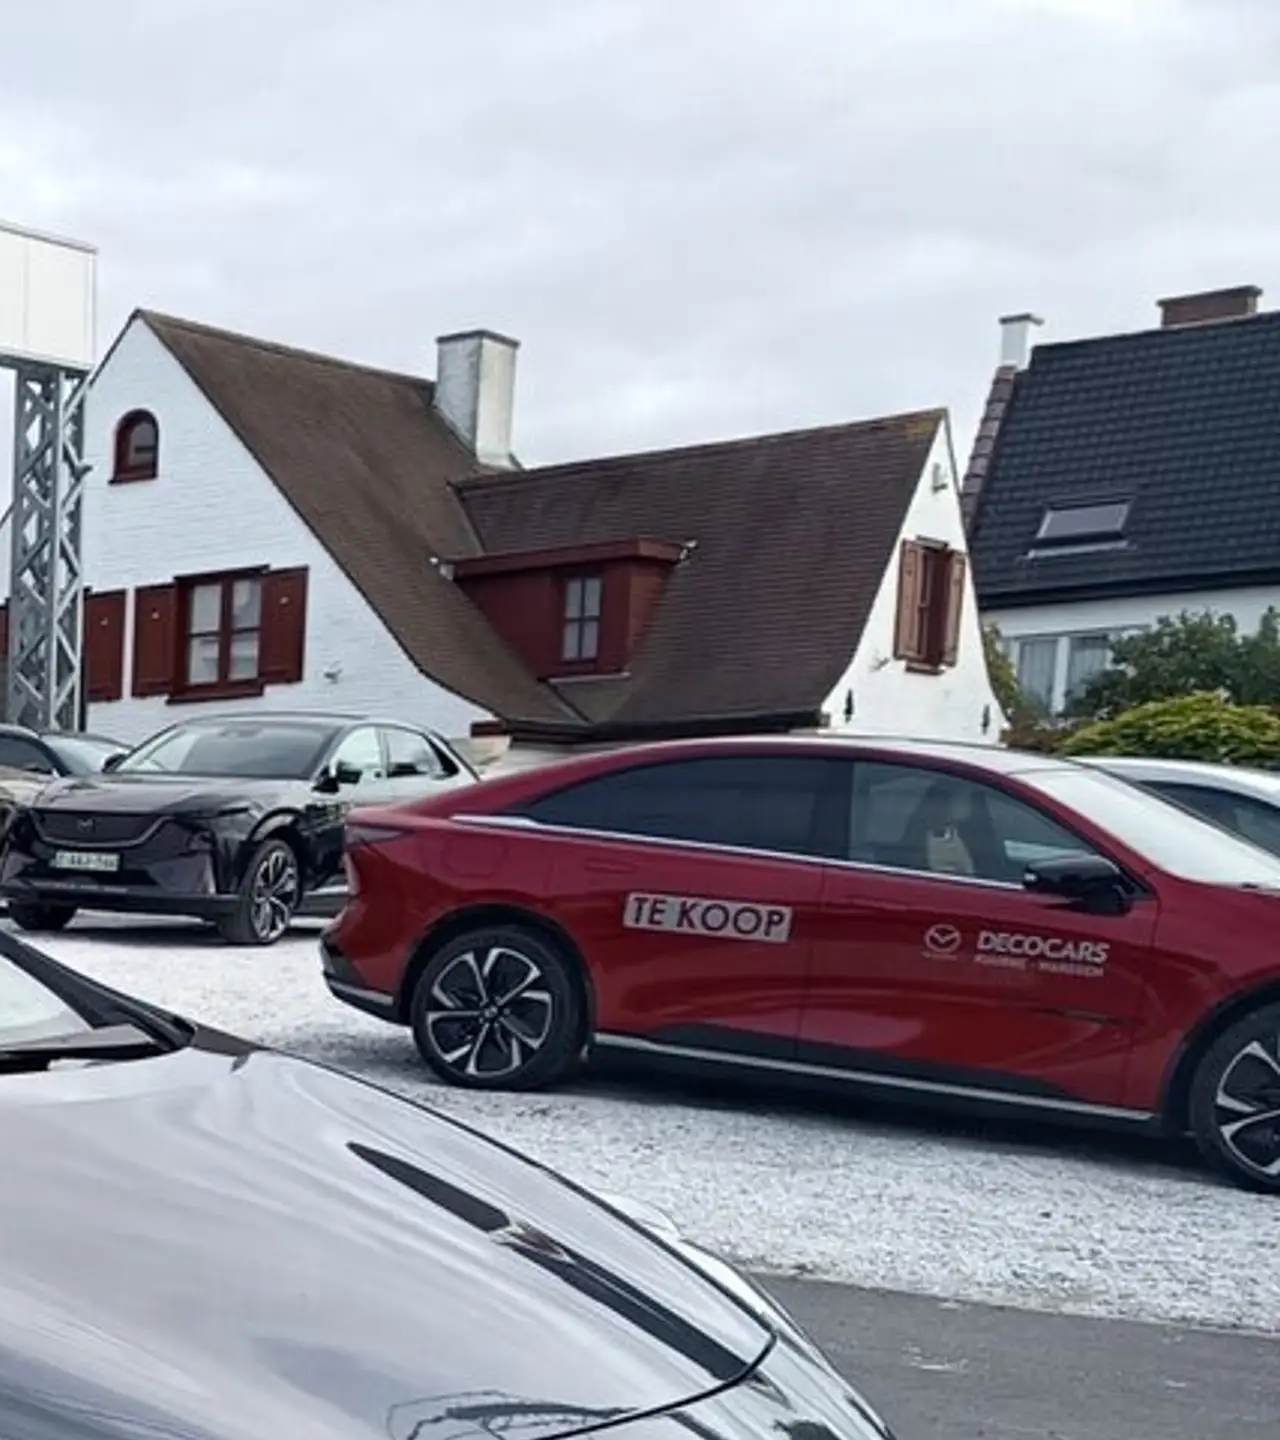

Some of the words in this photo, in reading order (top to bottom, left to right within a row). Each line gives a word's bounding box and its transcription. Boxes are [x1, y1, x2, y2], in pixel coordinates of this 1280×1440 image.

[633, 896, 669, 926] TE
[676, 902, 784, 937] KOOP
[977, 930, 1111, 963] DECOCARS
